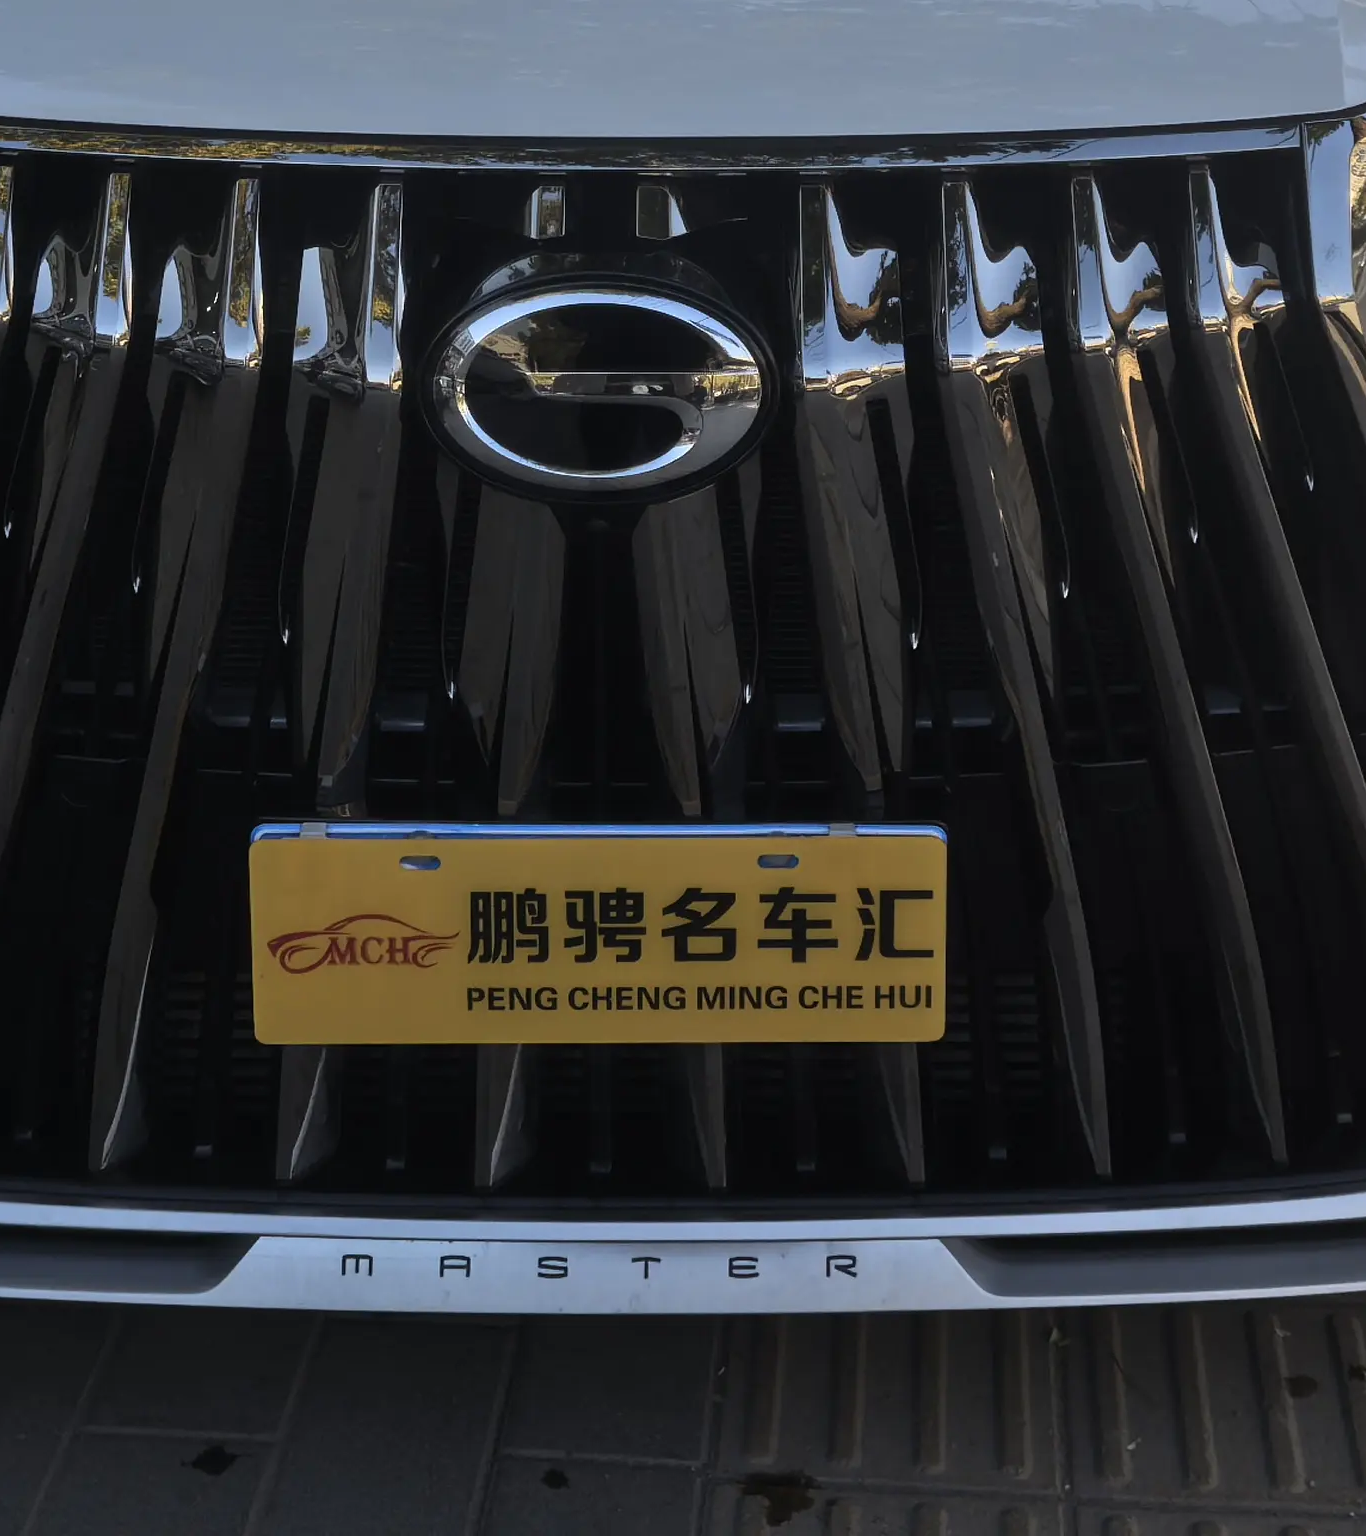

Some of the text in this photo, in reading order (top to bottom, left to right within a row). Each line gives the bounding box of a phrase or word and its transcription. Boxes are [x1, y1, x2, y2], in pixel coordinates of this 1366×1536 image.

[466, 886, 935, 964] 鹏骋名车汇
[466, 984, 933, 1011] PENG CHENG MING CHE HUI
[341, 1253, 858, 1279] MASTER
